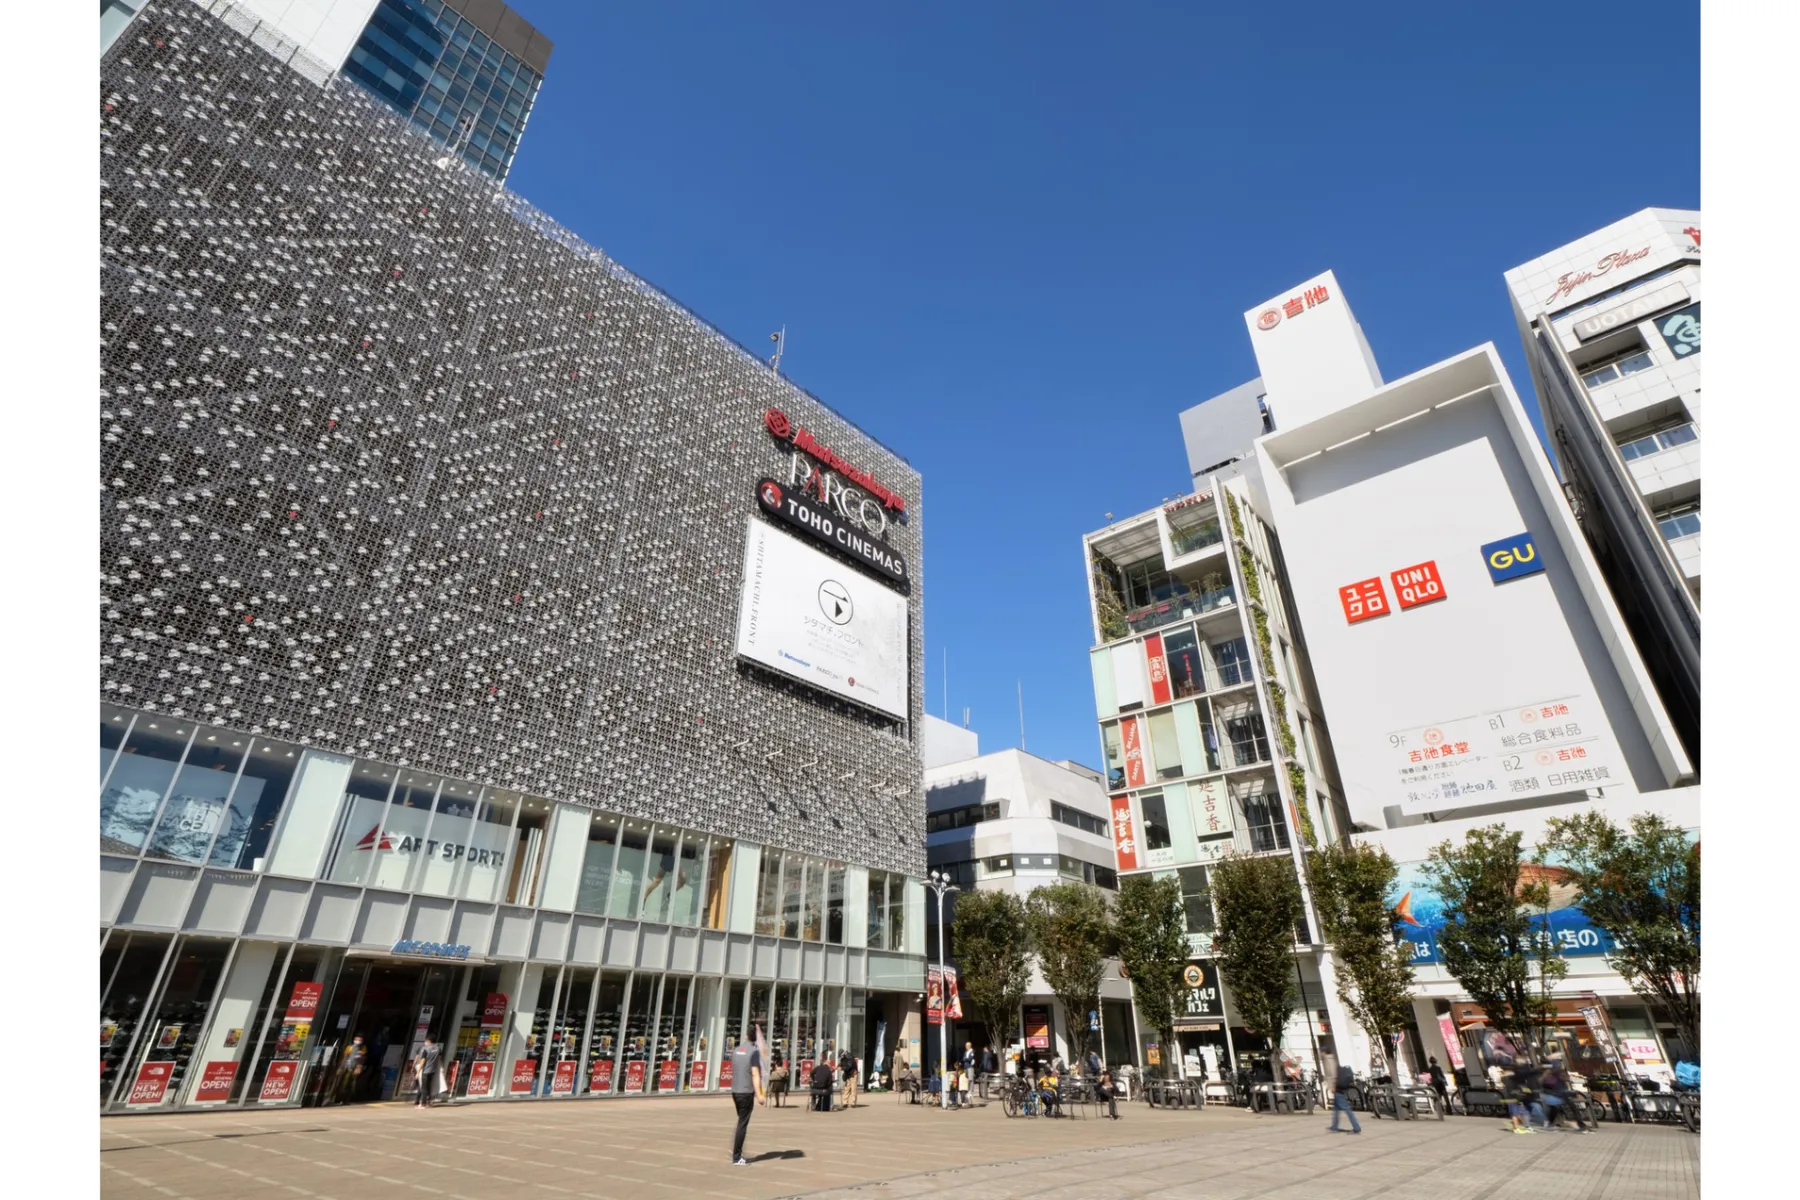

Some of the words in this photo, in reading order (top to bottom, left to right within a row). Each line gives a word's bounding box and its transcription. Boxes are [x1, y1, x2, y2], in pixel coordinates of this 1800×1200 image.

[1593, 246, 1651, 277] Plaza
[1282, 284, 1330, 319] 吉池
[793, 427, 905, 512] Matsuzakaya
[791, 452, 885, 535] PARCO
[788, 498, 832, 536] TOHO
[836, 527, 903, 575] CINEMAS
[1490, 543, 1535, 569] GU
[1397, 566, 1432, 587] UNI
[1346, 582, 1379, 602] ユニ
[1402, 580, 1439, 603] QLO
[1350, 596, 1383, 617] クロ
[1540, 703, 1569, 719] 吉池
[1488, 714, 1505, 730] B1
[1389, 734, 1407, 748] 9F
[1501, 722, 1582, 748] 総合食料品
[1408, 741, 1471, 764] 吉池食堂
[1556, 747, 1587, 762] 吉池
[1503, 755, 1524, 772] B2
[1509, 777, 1541, 793] 酒類
[1547, 766, 1611, 788] 日用雑貨
[290, 999, 318, 1008] OPEN!
[1177, 987, 1216, 1001] ンマルク
[134, 1084, 160, 1092] NEW
[201, 1080, 232, 1090] OPEN!
[263, 1087, 289, 1096] OPEN!
[132, 1091, 162, 1100] OPEN!
